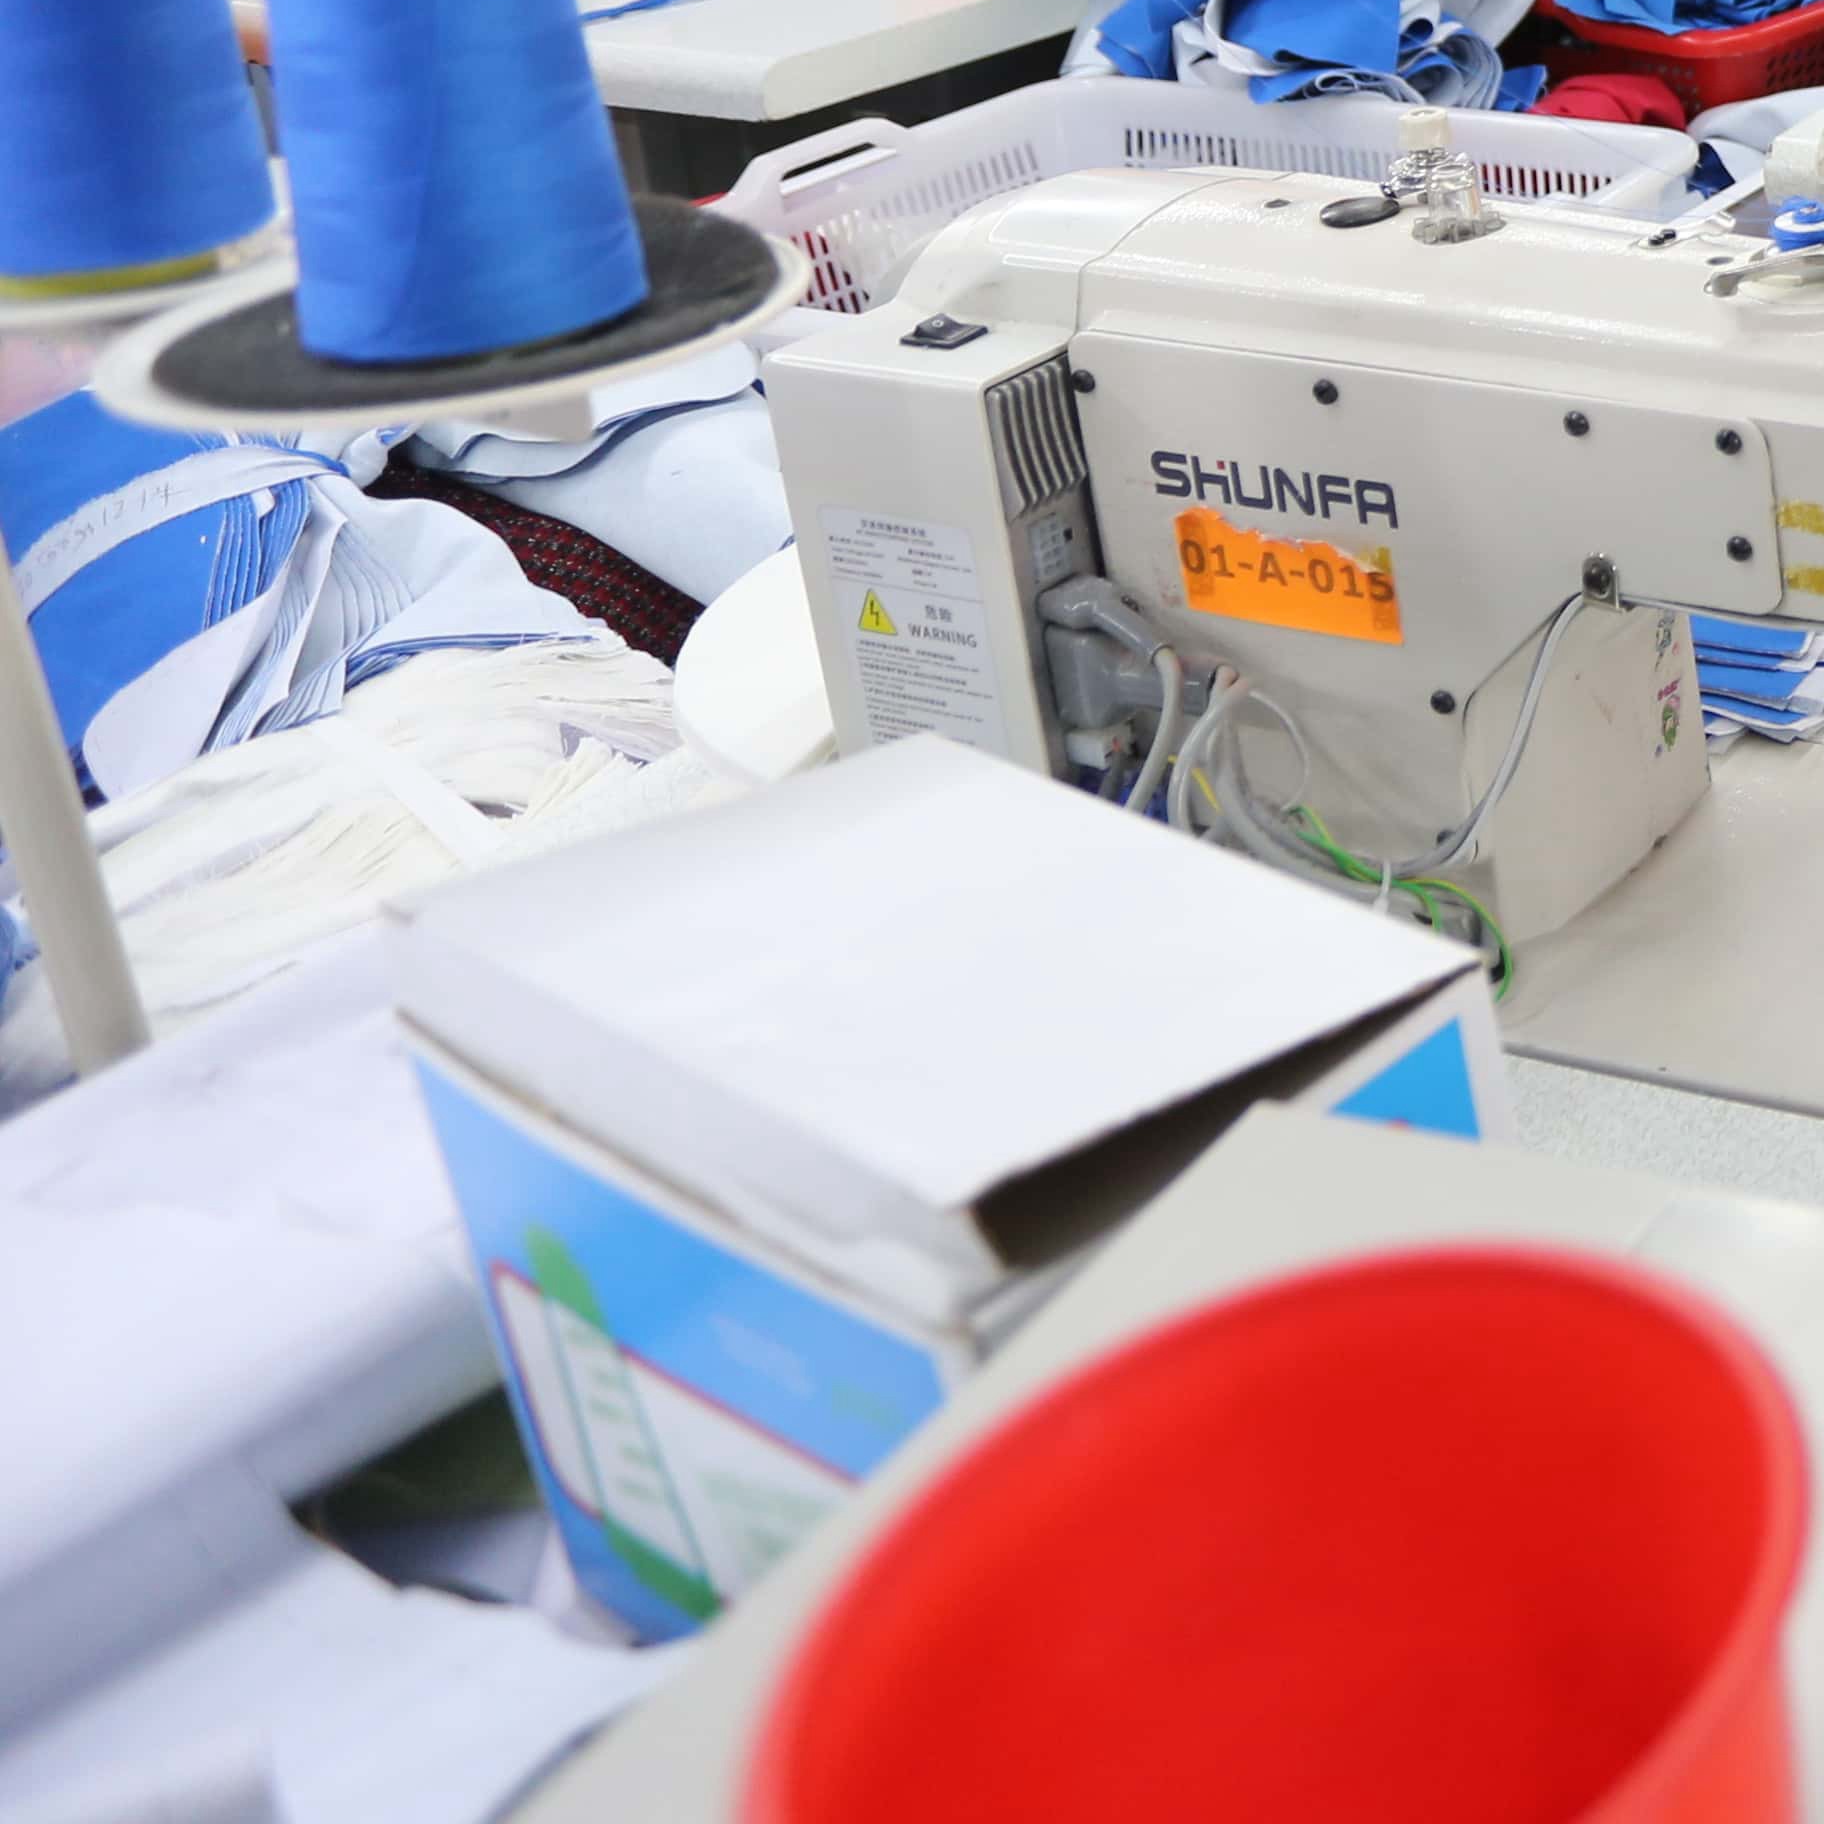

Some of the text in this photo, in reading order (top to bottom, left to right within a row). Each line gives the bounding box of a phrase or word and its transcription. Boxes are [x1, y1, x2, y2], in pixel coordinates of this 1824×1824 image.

[1150, 449, 1398, 529] SHUNFA
[1179, 539, 1395, 602] 01-A-015
[907, 622, 978, 649] WARNING
